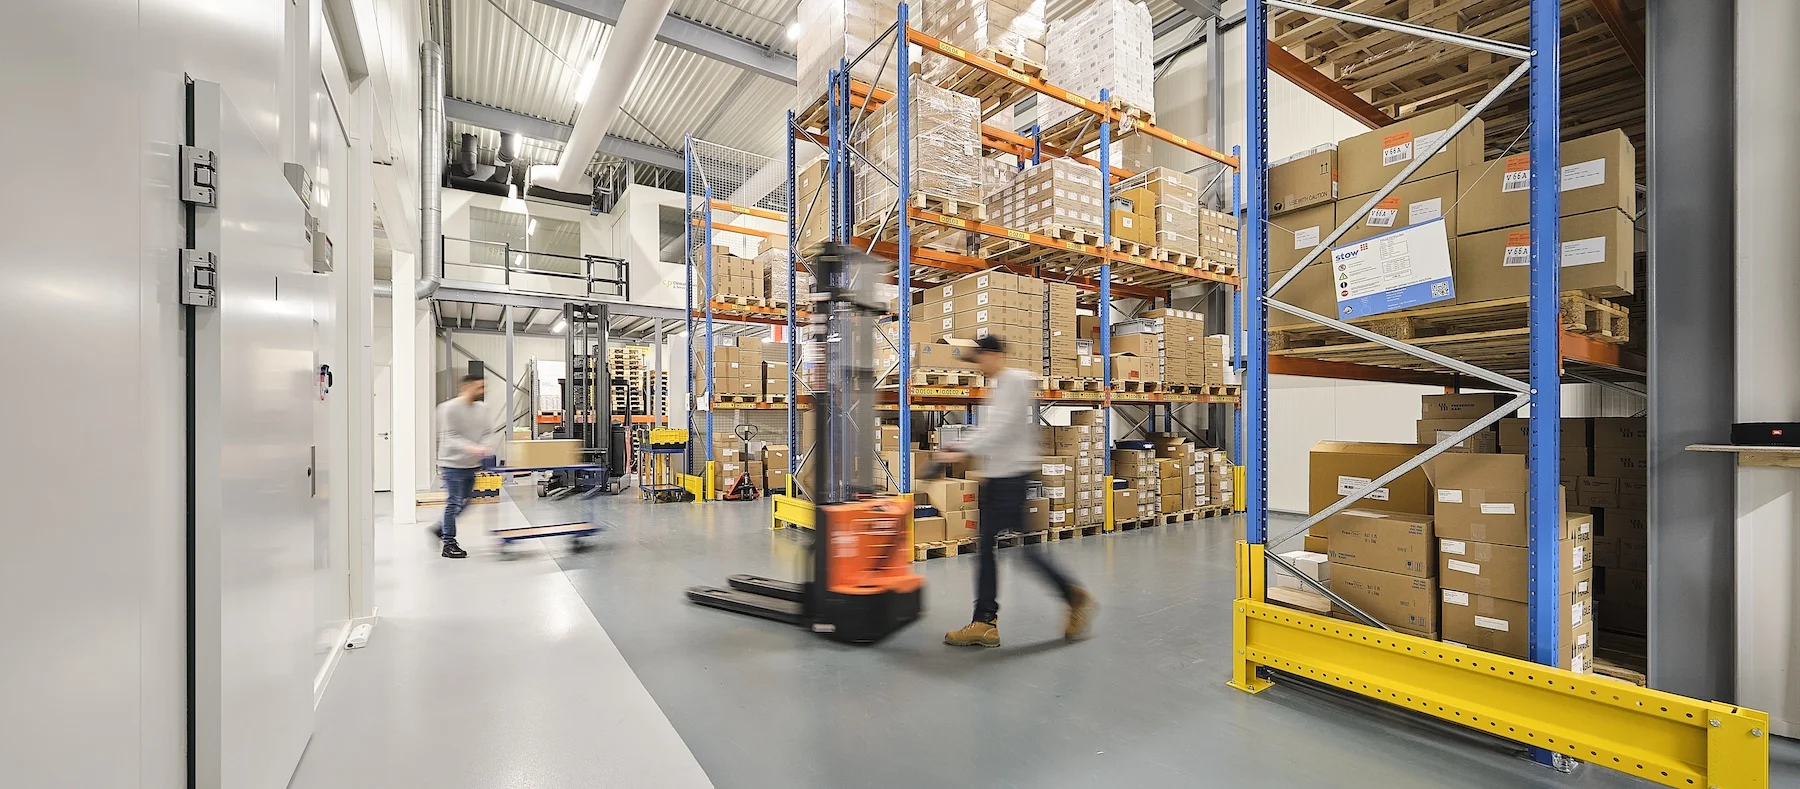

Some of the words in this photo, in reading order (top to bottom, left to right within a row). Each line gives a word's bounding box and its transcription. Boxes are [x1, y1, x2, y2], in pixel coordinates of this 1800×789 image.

[1506, 171, 1527, 181] V66A
[1308, 190, 1328, 202] CAUTION
[1335, 249, 1359, 262] stow
[1507, 246, 1528, 255] V66A
